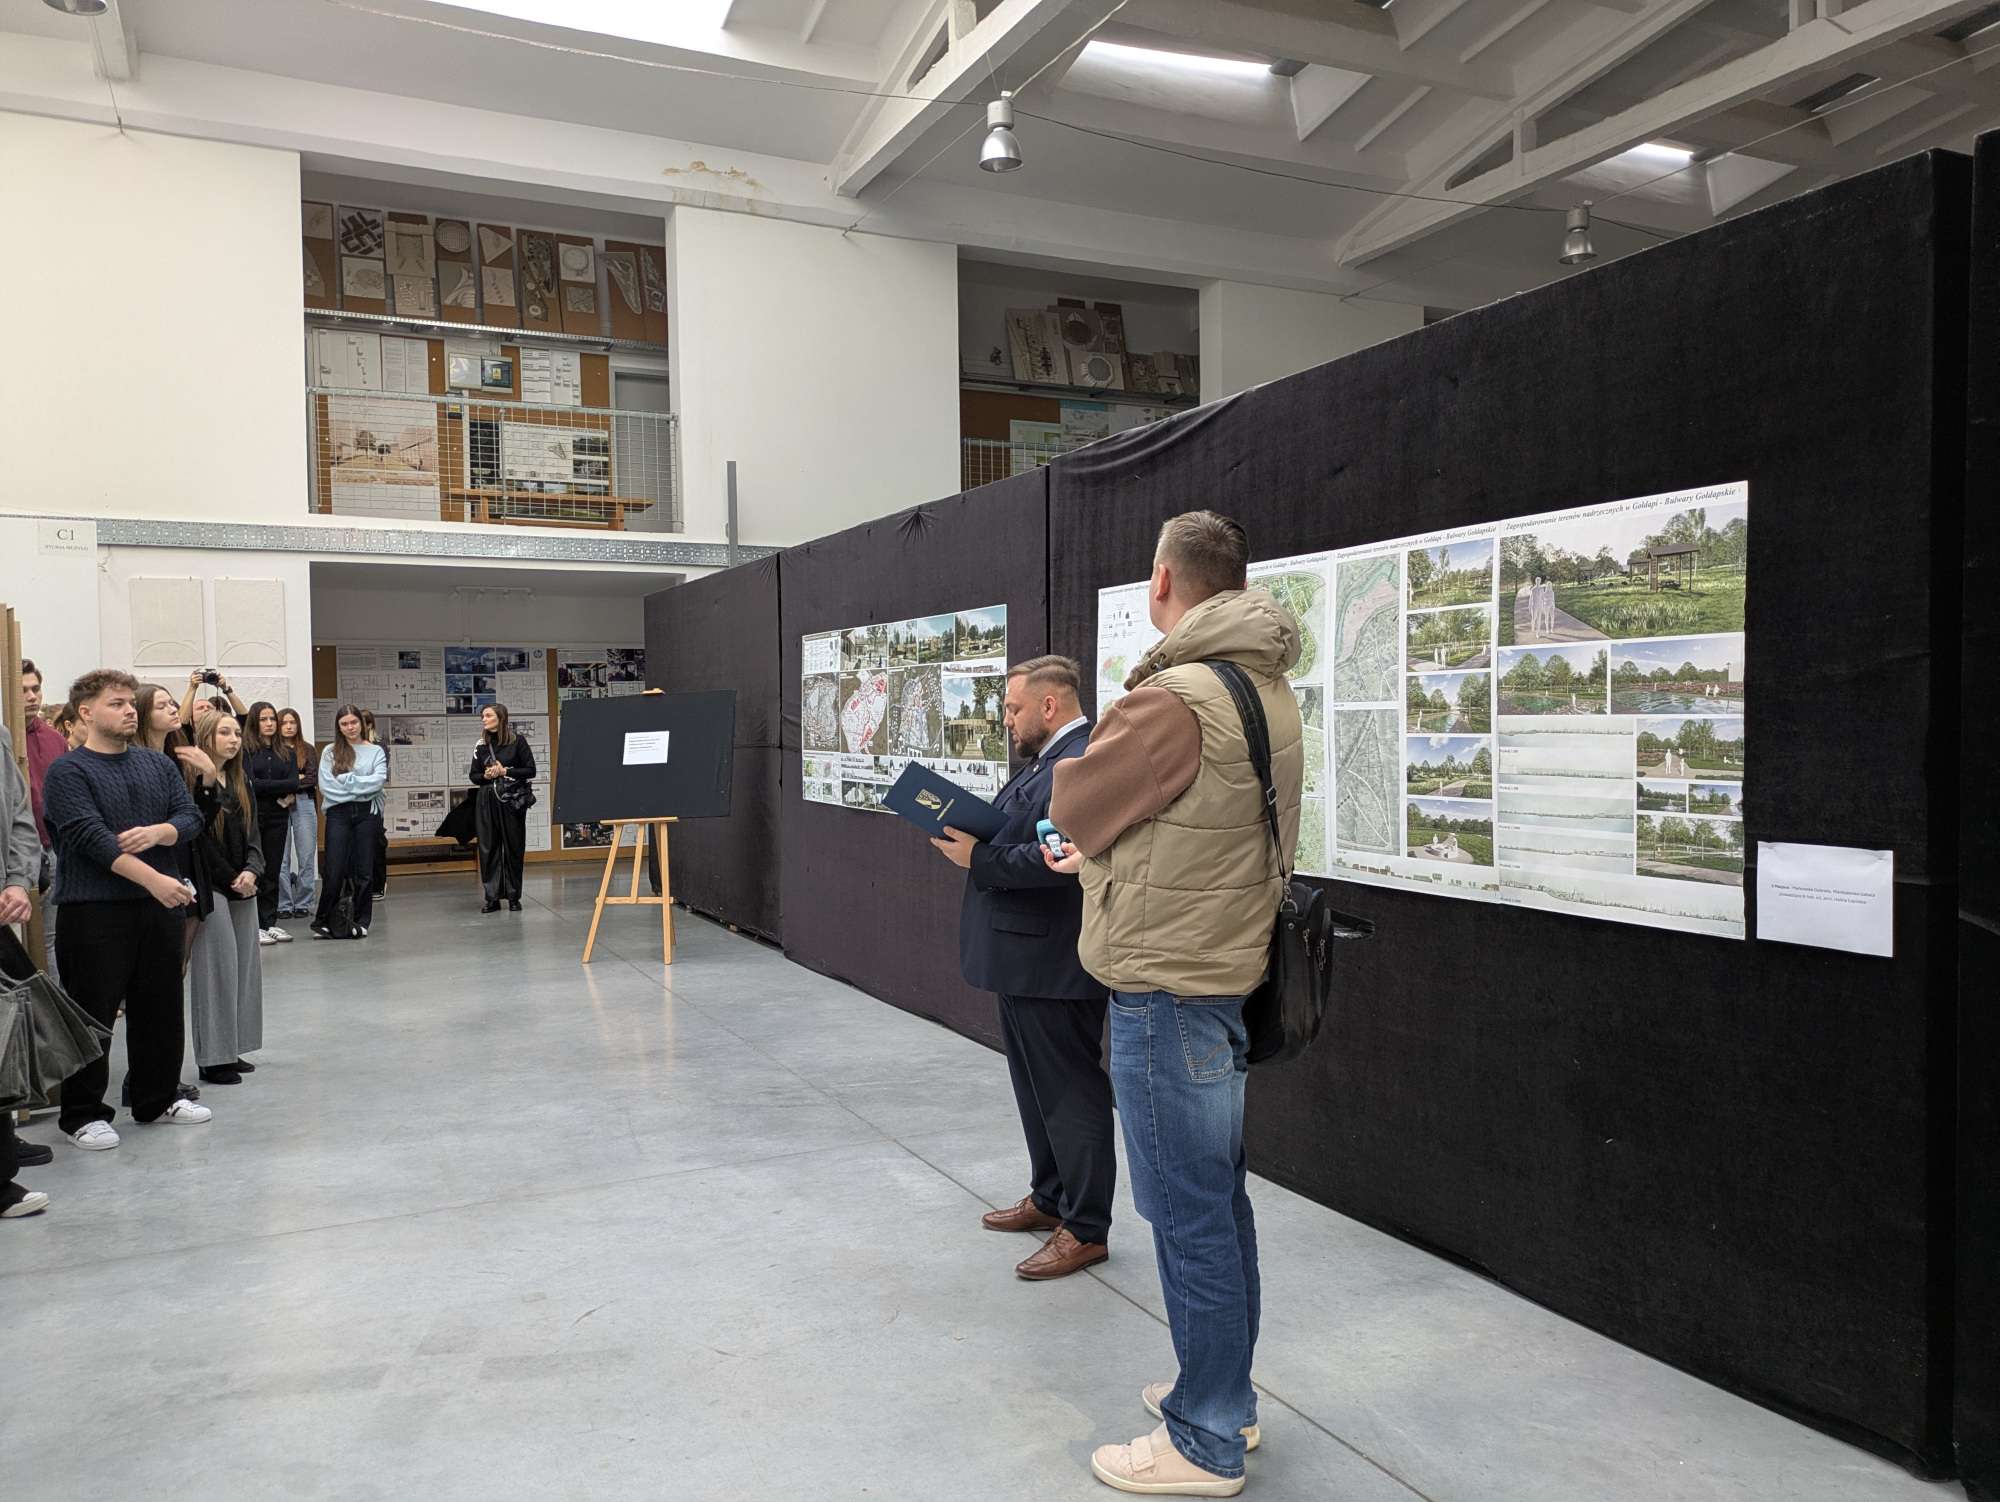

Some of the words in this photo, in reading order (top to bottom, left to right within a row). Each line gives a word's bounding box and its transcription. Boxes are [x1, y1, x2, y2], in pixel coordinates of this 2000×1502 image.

[1505, 515, 1557, 531] Zagospodarowanie
[1558, 511, 1581, 522] terenów
[1582, 504, 1624, 519] nadrzecznych
[1632, 499, 1659, 511] Gołdapi
[1664, 494, 1693, 507] Bulwary
[1695, 487, 1736, 501] Gołdapskie
[57, 529, 75, 541] C1
[1336, 547, 1372, 560] Zagospodarowanie
